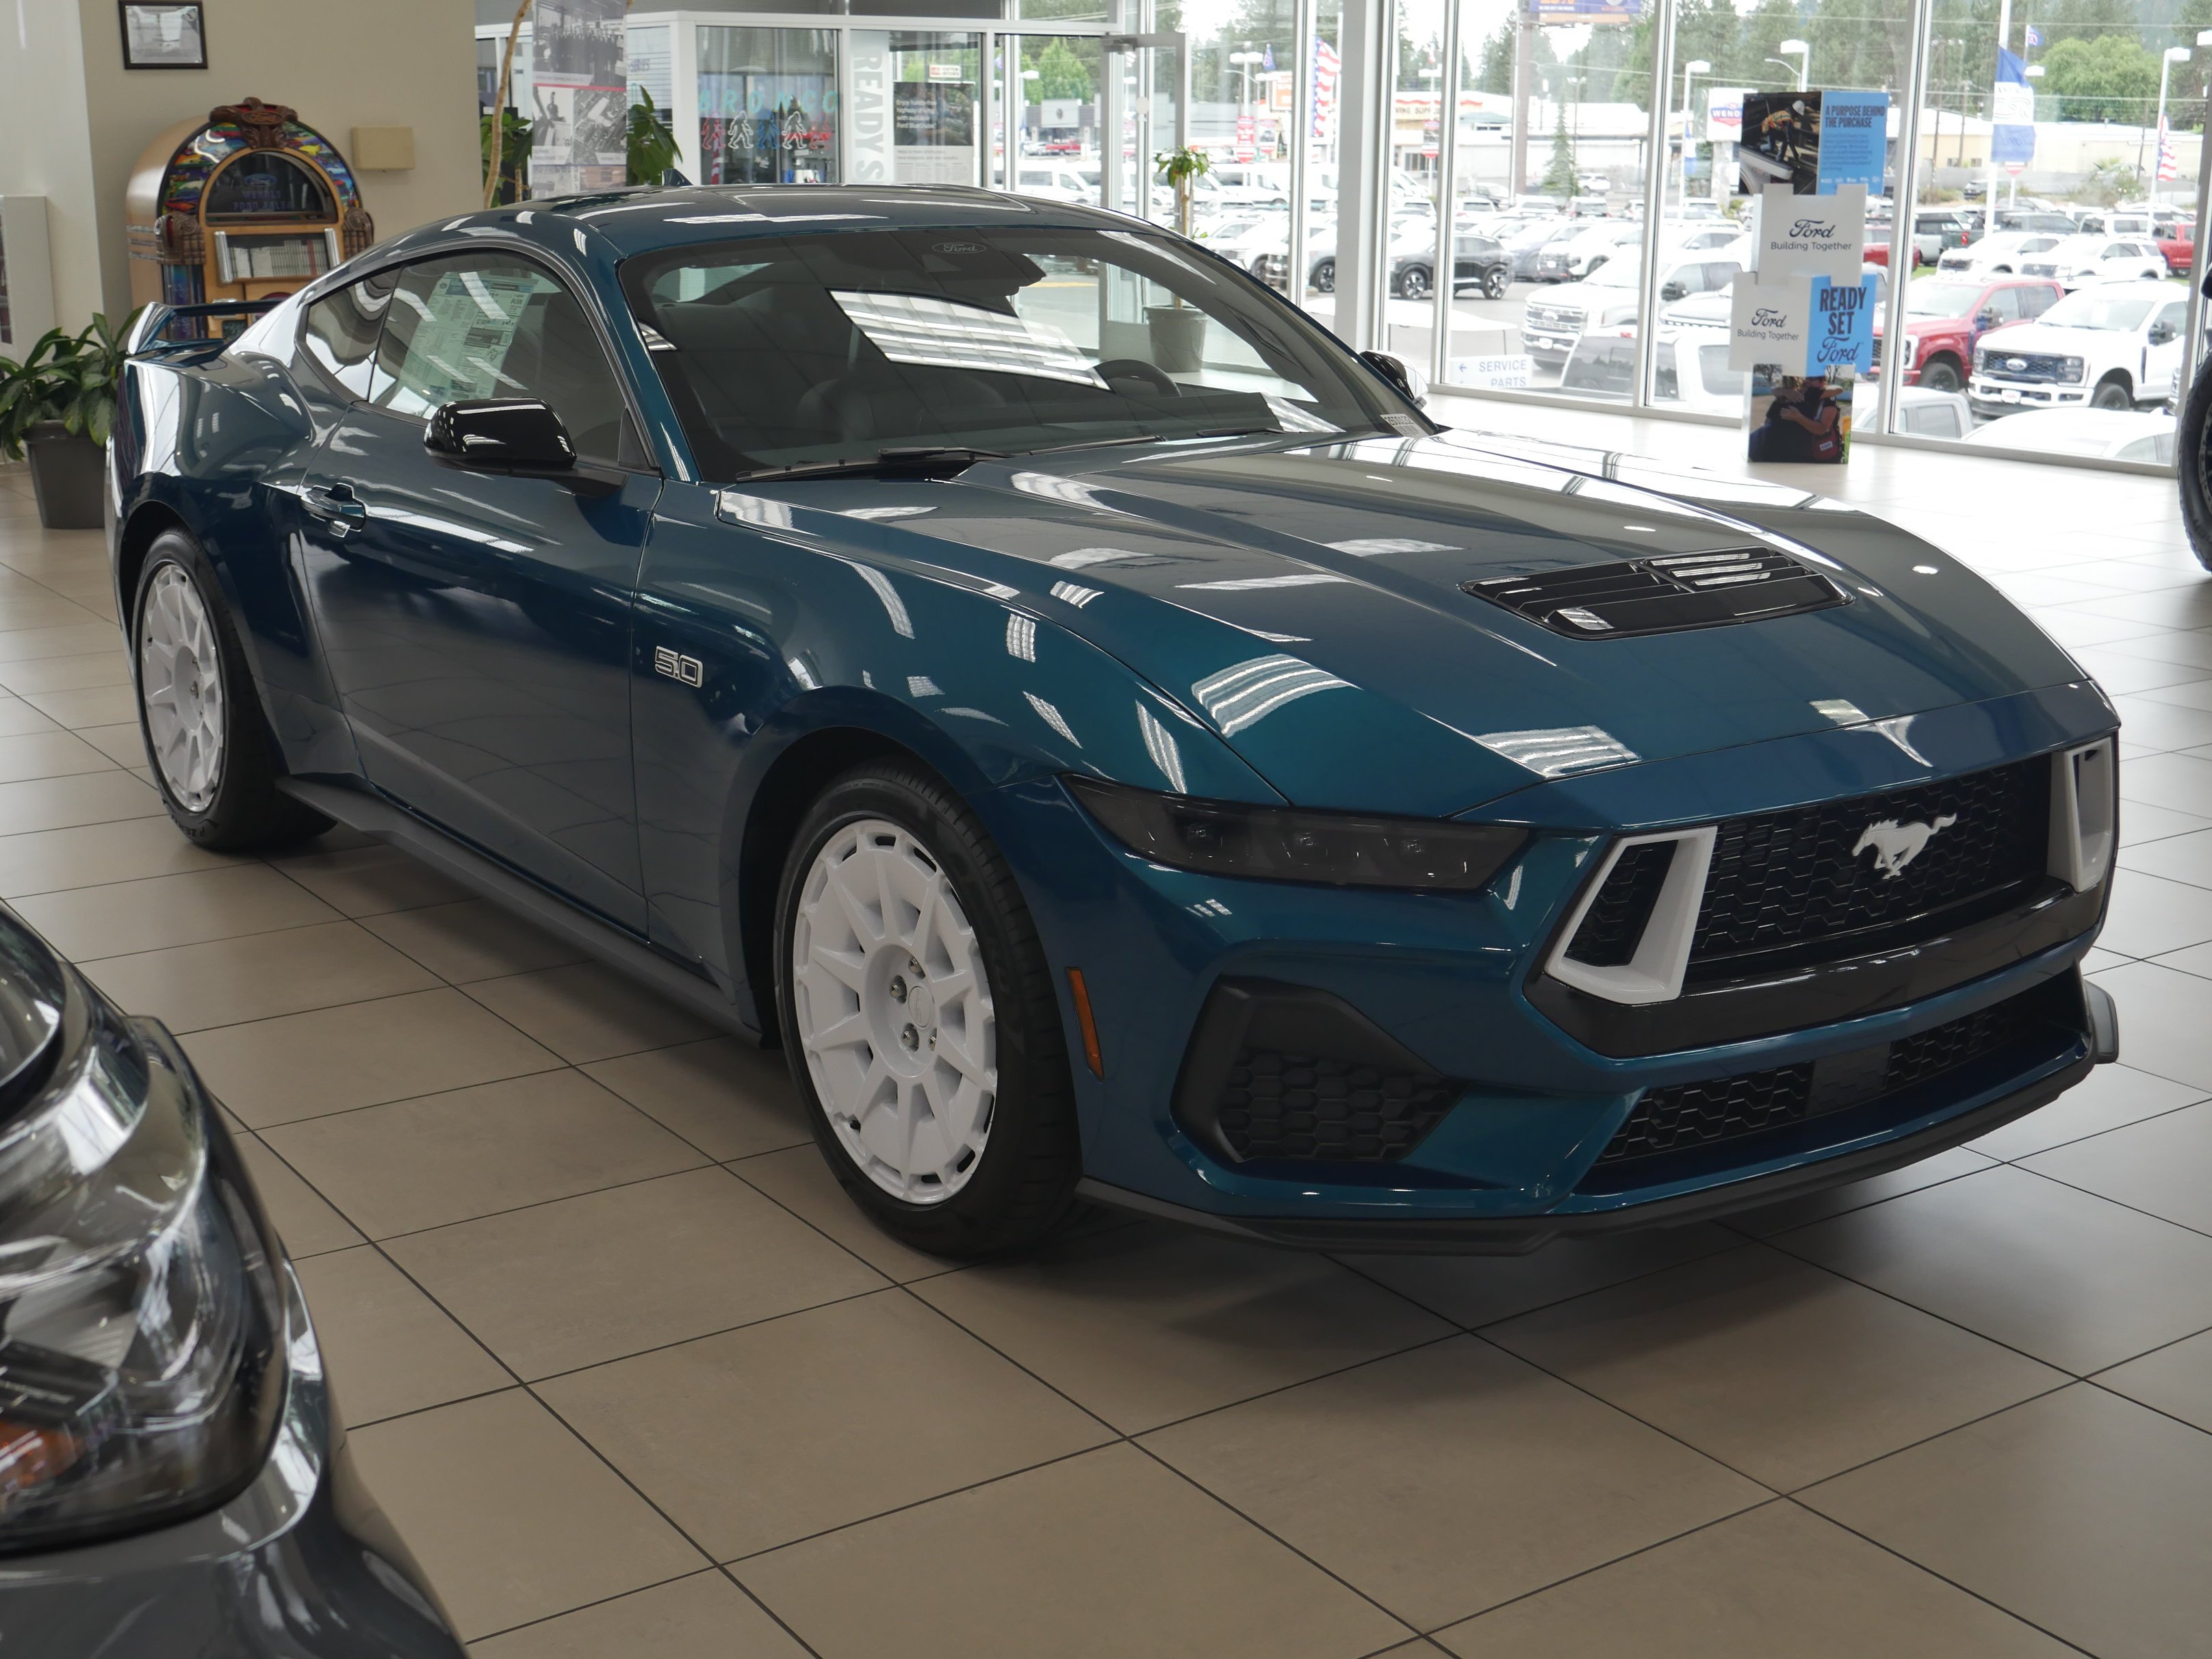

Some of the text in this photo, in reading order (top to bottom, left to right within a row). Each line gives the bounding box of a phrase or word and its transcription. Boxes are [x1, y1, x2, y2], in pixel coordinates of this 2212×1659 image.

[698, 89, 839, 114] BRONCO
[854, 49, 884, 154] READY
[1826, 105, 1886, 116] A PURPOSE BEHIND
[1825, 117, 1872, 128] THE PURCHASE
[1789, 219, 1836, 238] Ford
[1771, 242, 1852, 251] Building Together
[1819, 287, 1866, 311] READY
[1751, 308, 1787, 329] Ford
[1828, 311, 1854, 335] SET
[1737, 329, 1799, 341] Building Together
[1817, 336, 1860, 362] Ford
[1479, 359, 1527, 372] SERVICE
[1491, 376, 1527, 388] PARTS
[654, 645, 704, 689] 5.0
